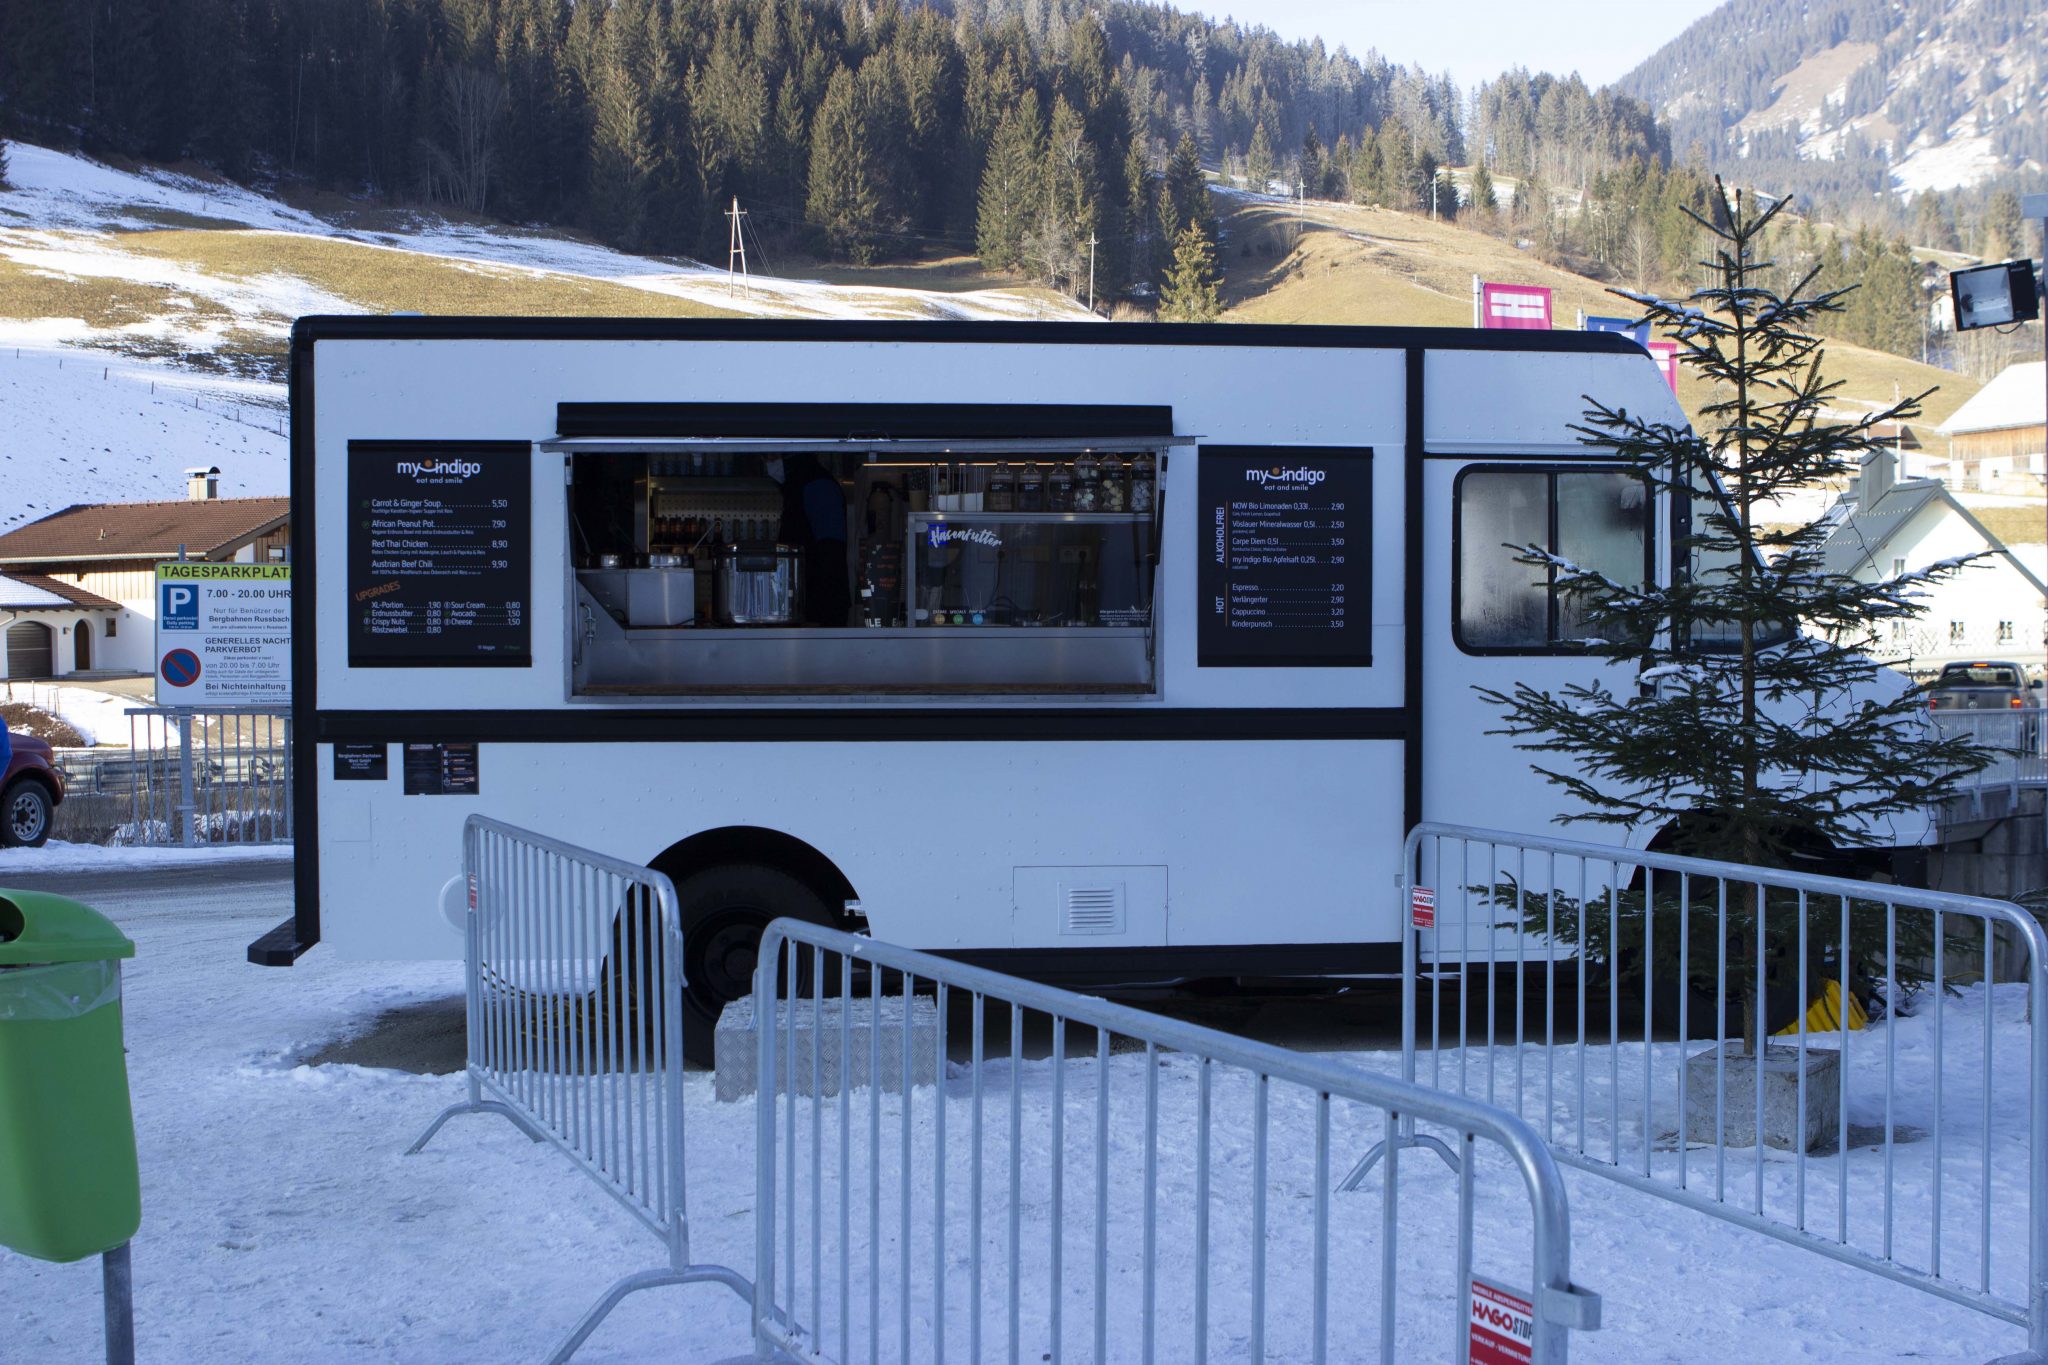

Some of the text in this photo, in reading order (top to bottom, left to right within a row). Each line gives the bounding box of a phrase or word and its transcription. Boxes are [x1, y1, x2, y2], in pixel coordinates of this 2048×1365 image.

[372, 499, 392, 507] Carrot
[393, 499, 399, 507] &
[400, 499, 422, 509] Ginger
[492, 499, 507, 508] 5,50
[1232, 502, 1247, 510] NOW
[1249, 502, 1258, 510] Bio
[1259, 502, 1292, 510] Limonaden
[1332, 503, 1344, 511] 2,90
[372, 520, 396, 528] African
[397, 520, 421, 528] Peanut
[492, 520, 506, 529] 7,90
[1232, 520, 1258, 528] Vöslauer
[1331, 521, 1344, 529] 2,50
[931, 526, 1002, 548] Hasenfutter
[1216, 507, 1224, 563] ALKOHOLFREI
[372, 540, 507, 549] Red Thai Chicken 8,90
[1232, 538, 1249, 546] Carpe
[1331, 539, 1344, 547] 3,50
[1273, 556, 1299, 564] Apfelsaft
[1331, 556, 1344, 564] 2,90
[492, 561, 507, 569] 9,90
[163, 566, 291, 577] TAGESPARKPLAT
[355, 581, 400, 601] UPGRADES
[1232, 584, 1344, 592] Espresso 2,20
[207, 590, 228, 598] 7.00
[238, 590, 265, 598] 20.00
[268, 590, 291, 598] UHR
[170, 588, 191, 614] P
[1216, 596, 1224, 613] HOT
[1232, 596, 1268, 604] Verlängerter
[427, 610, 441, 618] 0,80
[1232, 609, 1265, 617] Cappuccino
[372, 618, 390, 627] Crispy
[427, 618, 441, 626] 0,80
[1232, 621, 1344, 629] Kinderpunsch 3,50
[1473, 1300, 1513, 1331] HAGO
